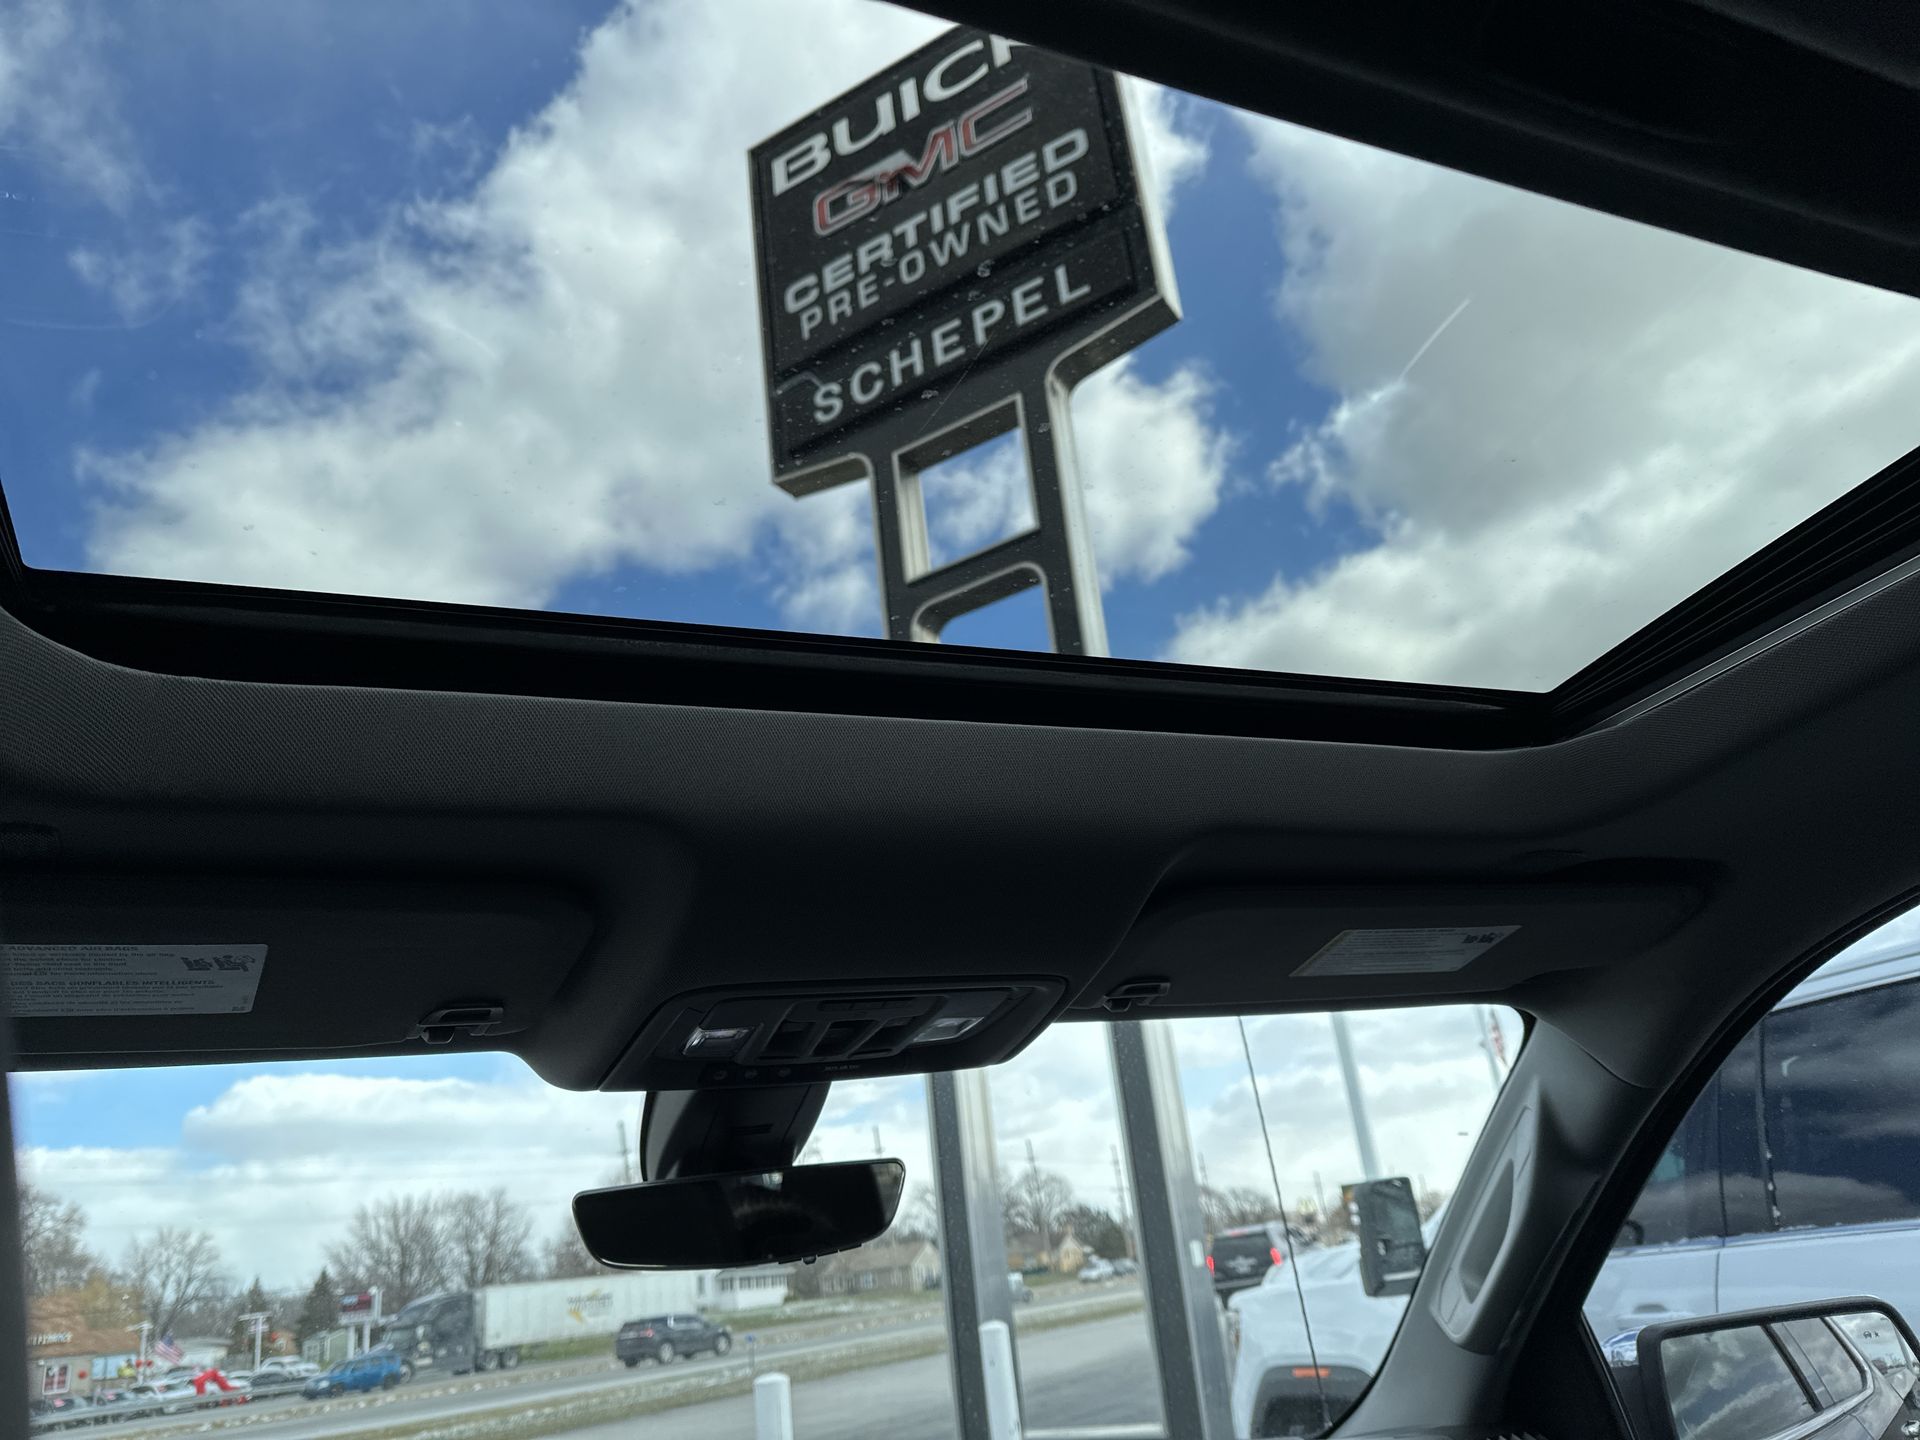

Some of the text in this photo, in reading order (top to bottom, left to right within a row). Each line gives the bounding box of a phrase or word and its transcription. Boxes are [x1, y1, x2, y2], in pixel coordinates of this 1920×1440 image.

[784, 128, 1089, 314] CERTIFIED
[813, 74, 1034, 237] GMC
[800, 172, 1077, 340] PRE-OWNED
[813, 266, 1090, 424] SCHEPEL
